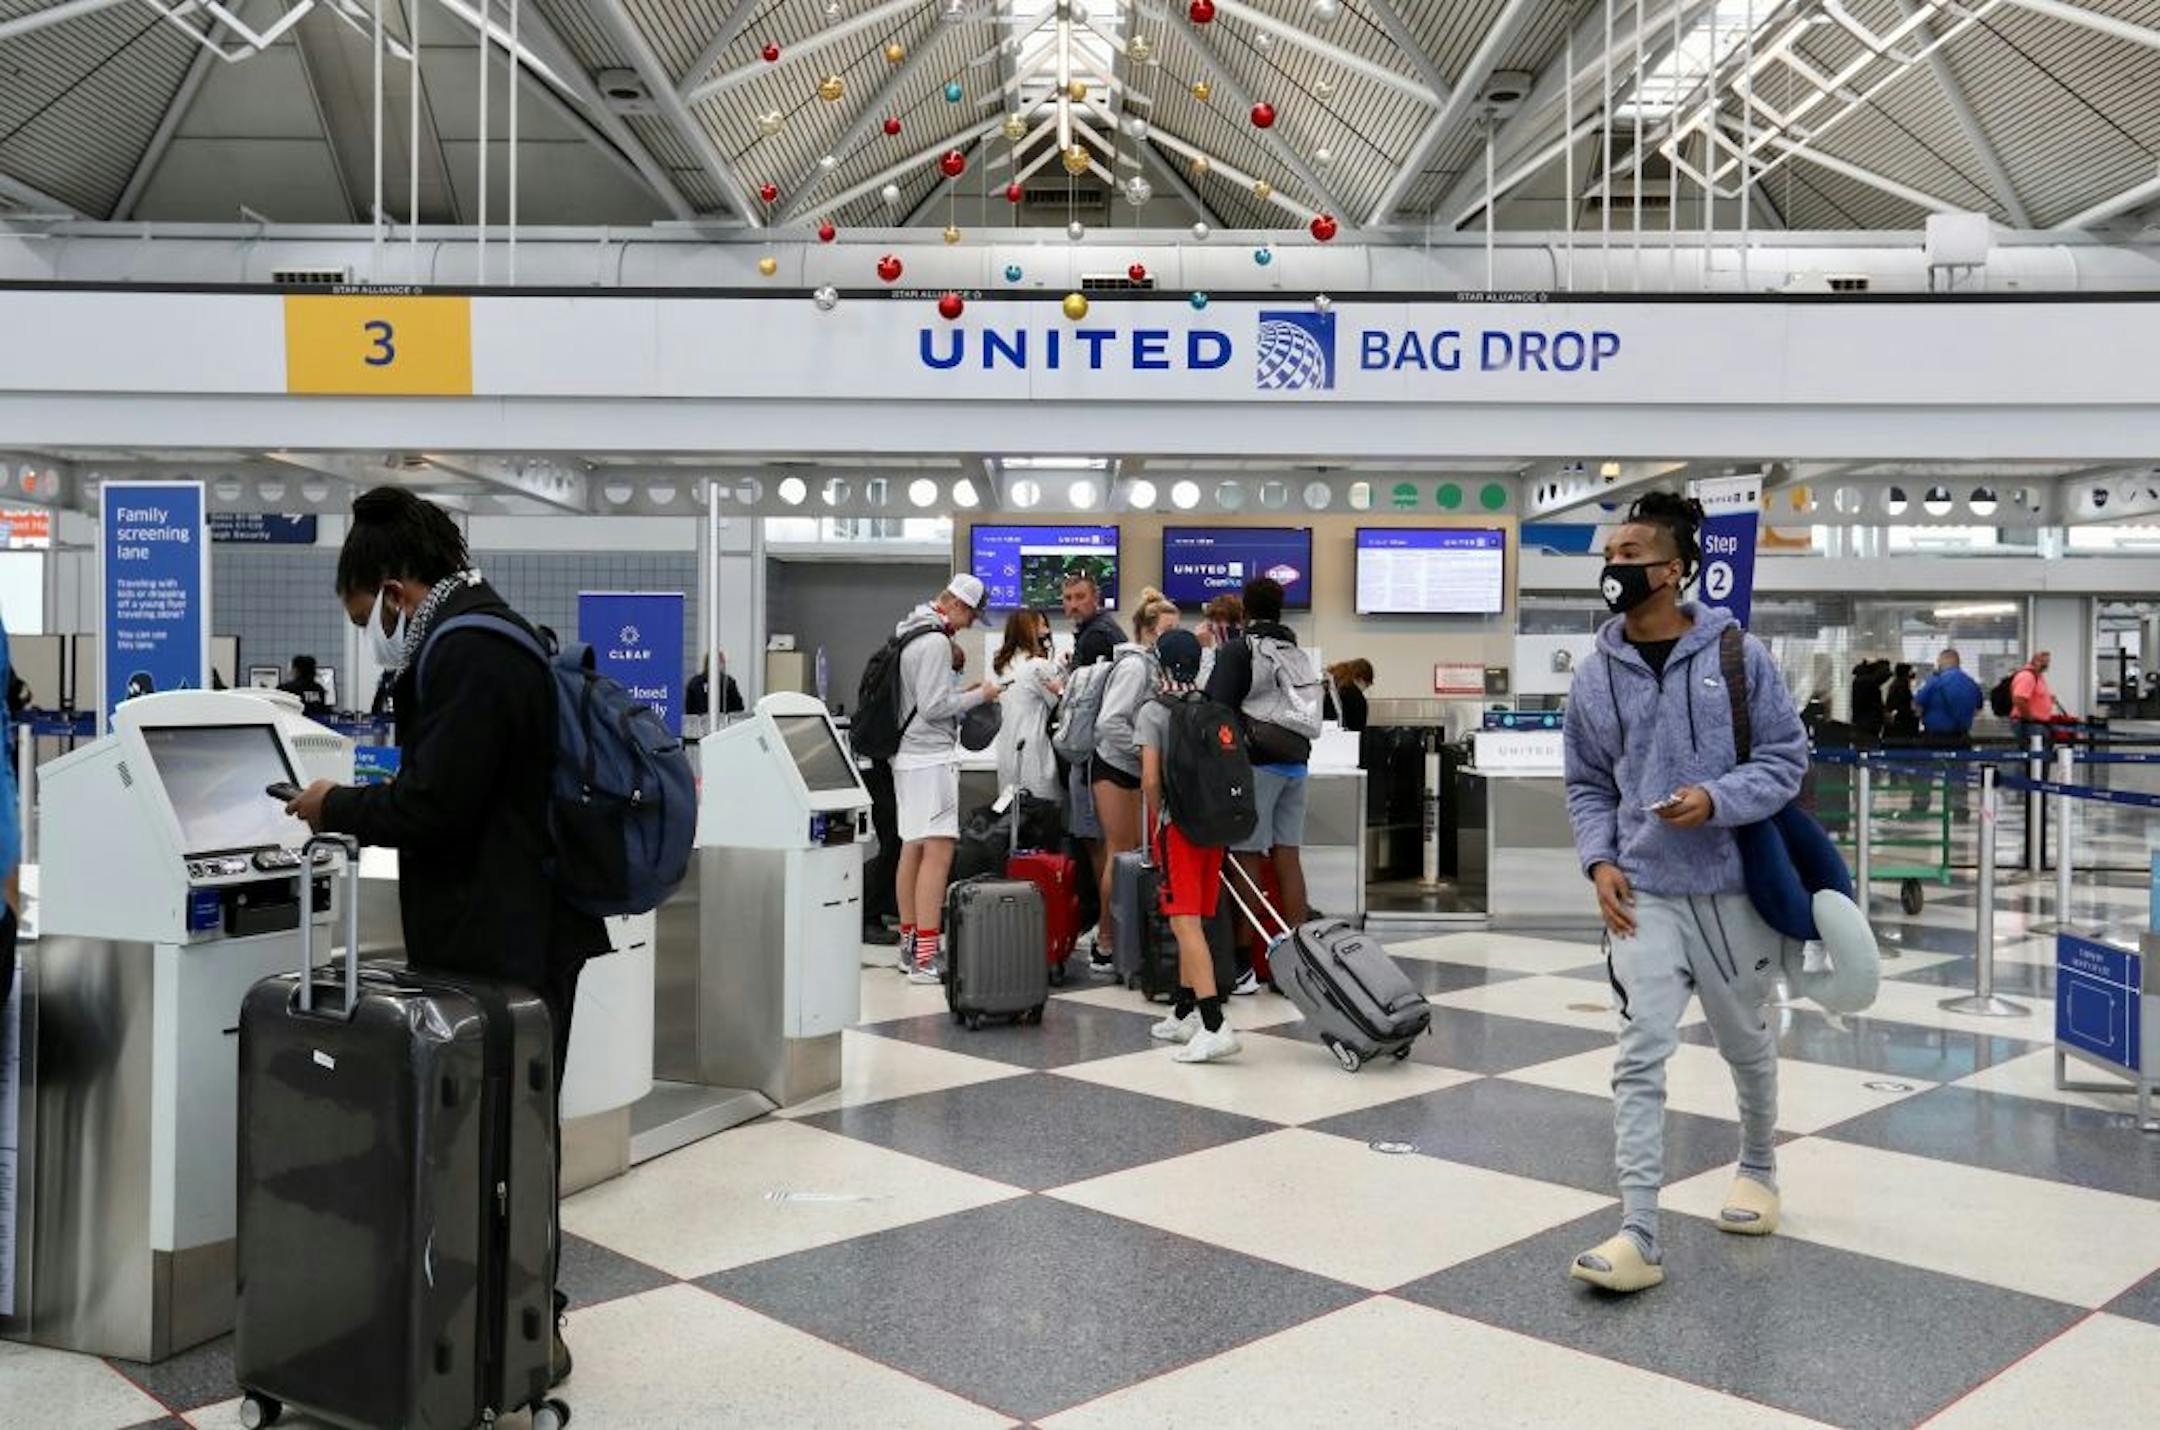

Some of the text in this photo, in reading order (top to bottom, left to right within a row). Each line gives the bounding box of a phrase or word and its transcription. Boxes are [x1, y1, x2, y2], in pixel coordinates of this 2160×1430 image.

[332, 286, 410, 294] STAR ALLIANCE
[1456, 293, 1537, 302] STAR ALLIANCE
[364, 320, 395, 366] 3
[920, 328, 1621, 372] UNITED BAG DROP
[117, 507, 168, 524] Family
[117, 526, 189, 543] screening
[117, 545, 149, 560] lane
[1705, 535, 1737, 555] Step
[1174, 564, 1227, 574] UNITED
[1712, 567, 1726, 591] 2
[608, 650, 651, 659] CLEAR
[1499, 746, 1554, 757] UNITED
